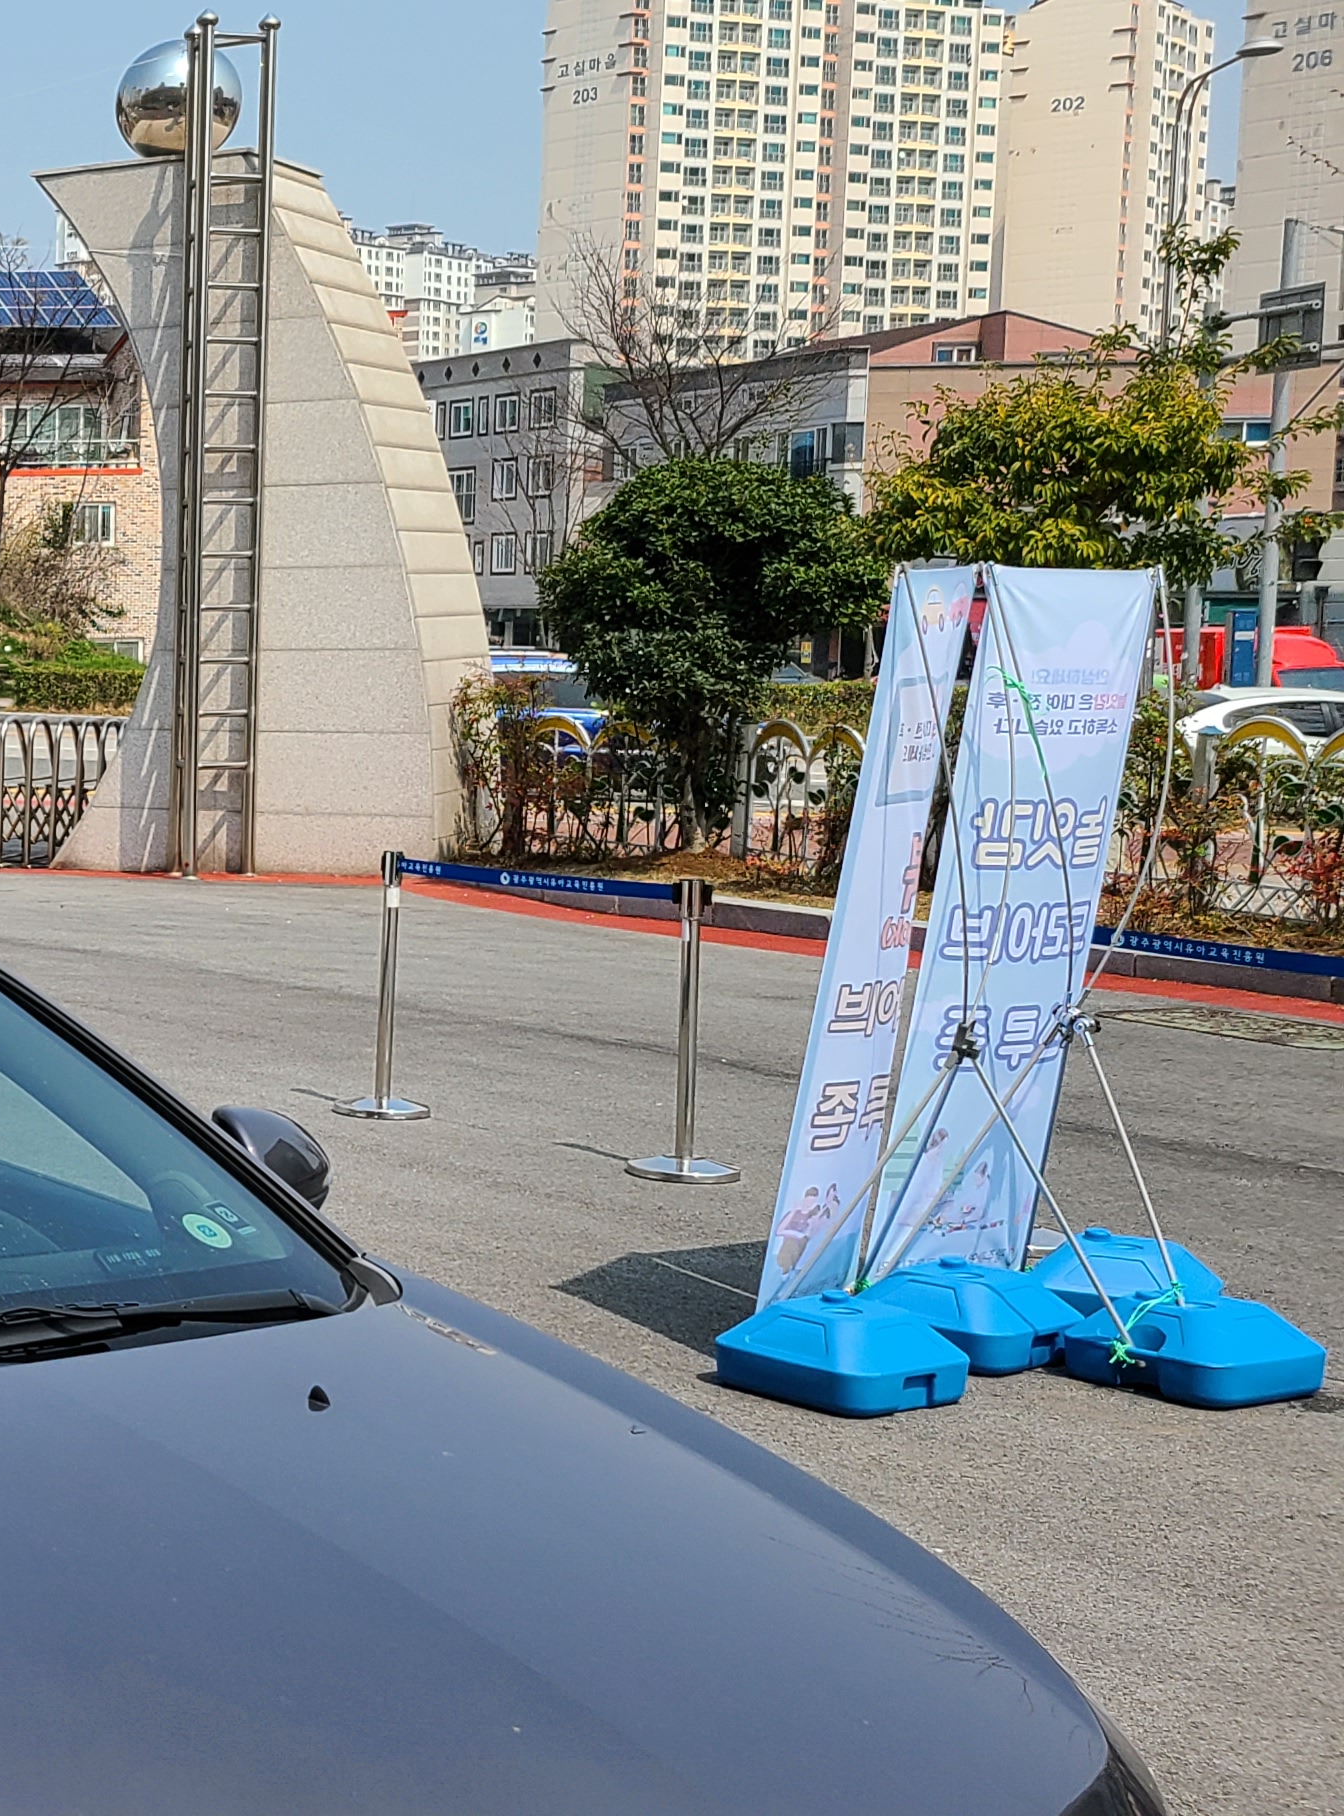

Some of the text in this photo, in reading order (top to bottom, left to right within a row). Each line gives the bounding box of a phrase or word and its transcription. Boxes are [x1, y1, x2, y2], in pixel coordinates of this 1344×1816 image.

[1272, 11, 1344, 39] 고실마
[556, 52, 618, 79] 고실마을
[1291, 49, 1333, 73] 206
[572, 86, 598, 105] 203
[1050, 95, 1086, 114] 202
[1129, 935, 1266, 965] 광주광역시유아교육진흥원
